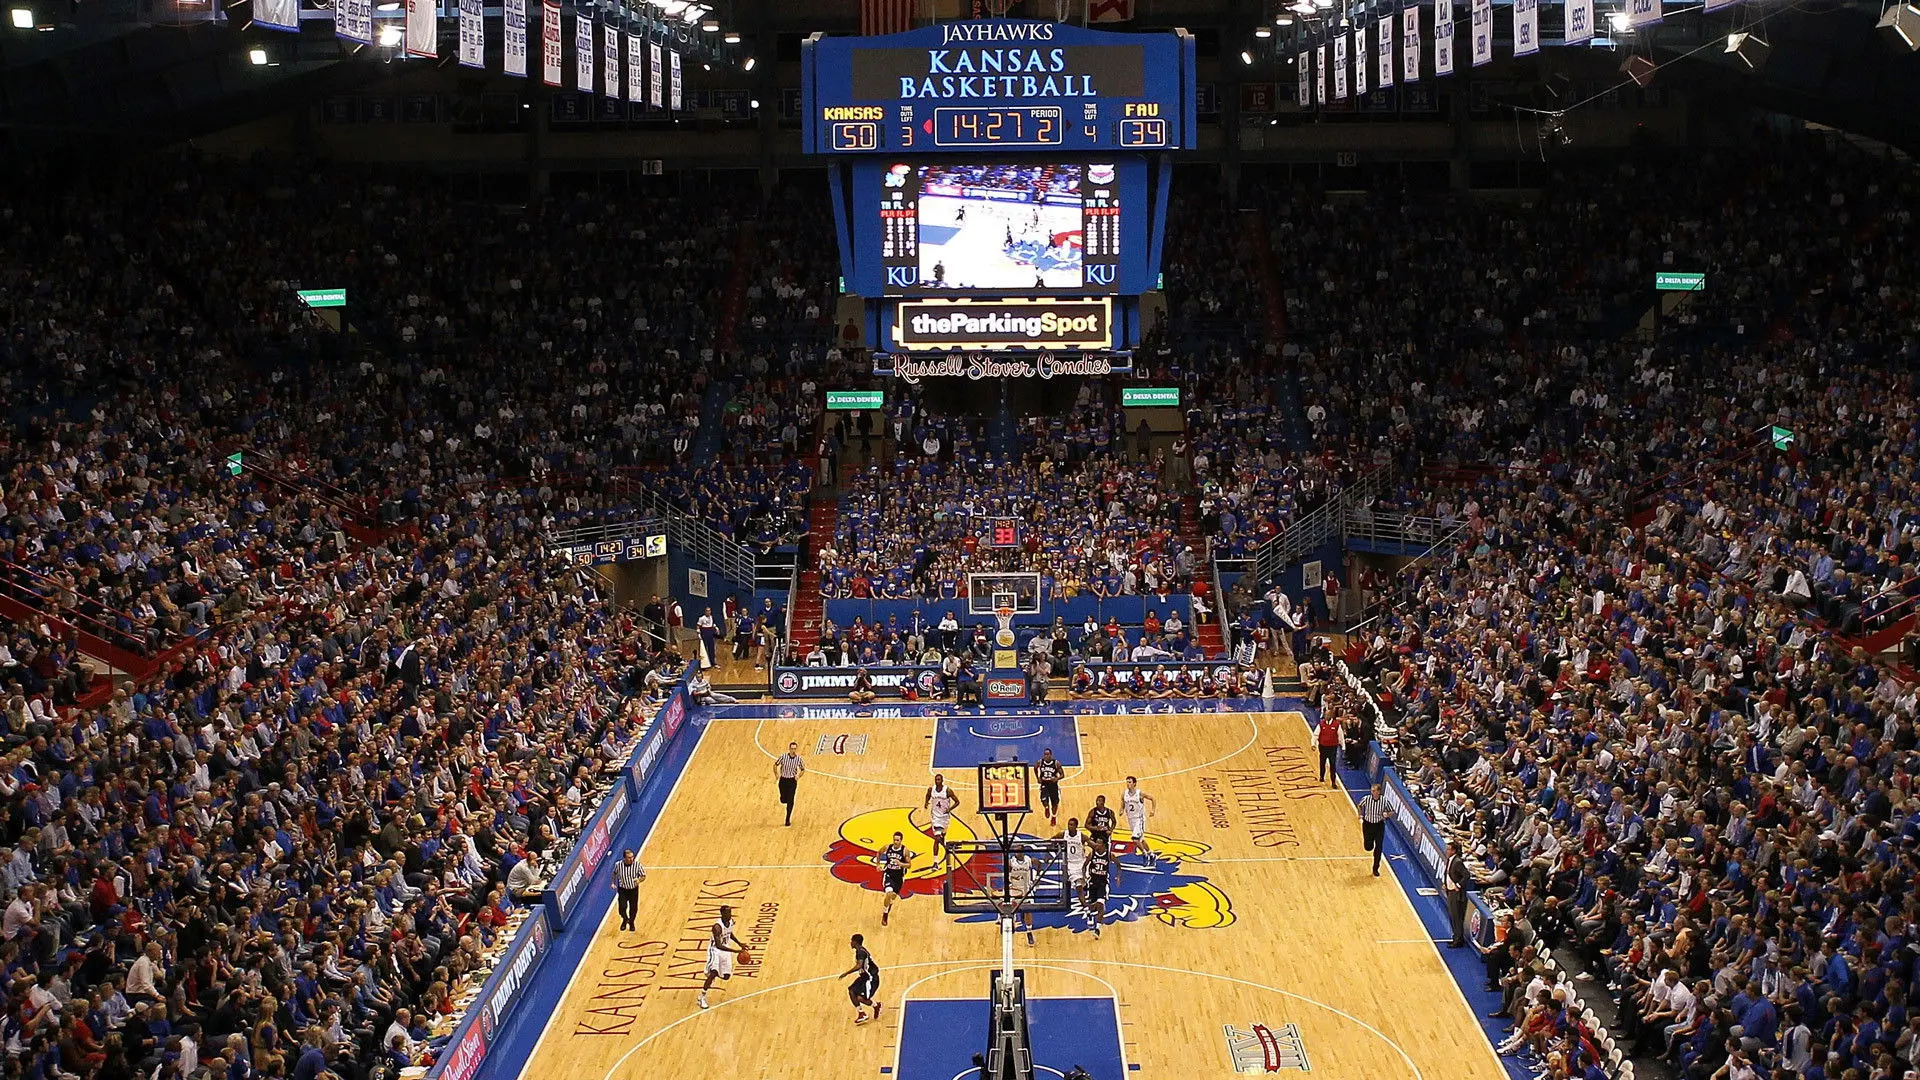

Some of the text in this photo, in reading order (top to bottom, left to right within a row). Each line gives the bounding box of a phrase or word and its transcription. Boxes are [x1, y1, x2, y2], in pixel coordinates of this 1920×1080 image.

[942, 23, 1053, 46] JAYHAWKS
[929, 48, 1065, 74] KANSAS
[900, 75, 1097, 99] BASKETBALL
[824, 106, 884, 121] KANSAS
[1031, 109, 1058, 119] PERIOD
[1125, 103, 1159, 117] FAU
[843, 125, 873, 148] 50
[902, 126, 913, 147] 3
[954, 112, 1021, 140] 14:27
[1037, 119, 1052, 142] 2
[1084, 125, 1097, 143] 4
[1132, 122, 1161, 144] 34
[886, 266, 918, 288] KU
[1085, 264, 1117, 286] KU
[911, 312, 1098, 337] theParkingSpot
[891, 350, 1113, 385] Russell Stover Candies
[994, 519, 1016, 528] 14:27
[994, 528, 1015, 544] 33
[573, 545, 592, 553] KANSAS
[600, 542, 621, 554] 14:27
[611, 554, 616, 562] 2
[631, 547, 643, 557] 34
[578, 555, 590, 565] 50
[802, 674, 857, 691] JIMMY
[990, 682, 1021, 695] O'Reilly
[1263, 746, 1327, 799] KANSAS
[936, 800, 942, 808] 4
[991, 783, 1019, 806] 33
[1198, 776, 1230, 829] Allen Fieldhouse
[1129, 804, 1135, 812] 2
[1216, 769, 1300, 847] JAYHAWKS
[1070, 845, 1076, 854] 0
[1095, 863, 1104, 871] 31
[658, 879, 751, 991] JAYHAWKS
[745, 902, 780, 951] Fieldhouse
[491, 936, 537, 1026] JIMMY JOHN'S
[573, 940, 669, 1036] KANSAS
